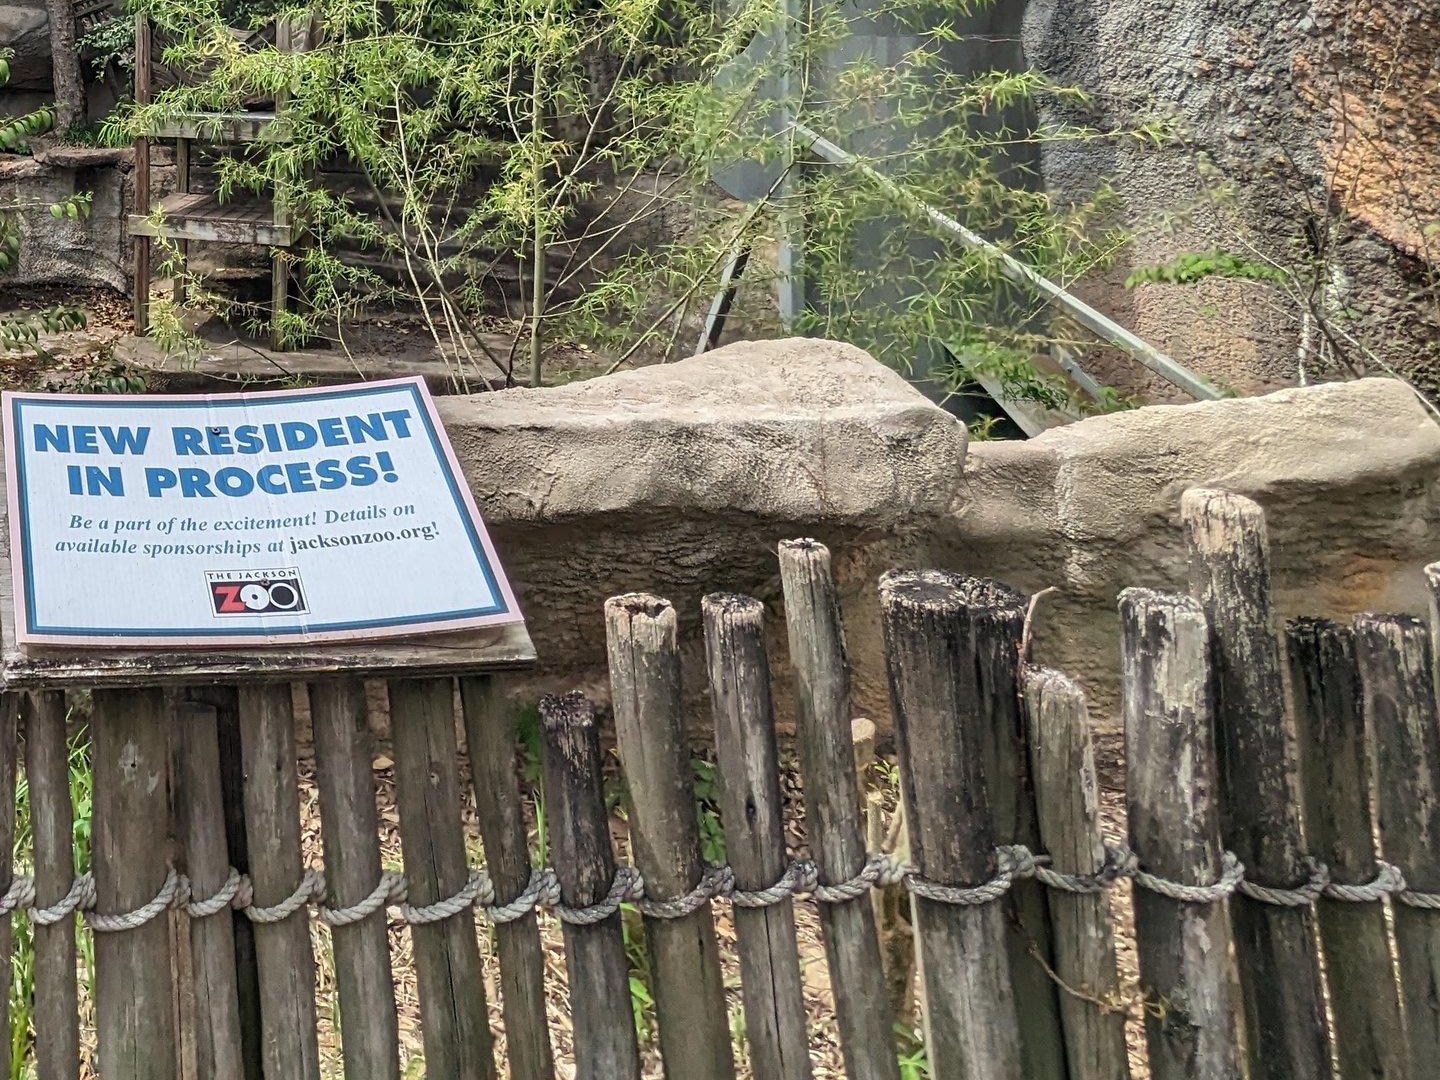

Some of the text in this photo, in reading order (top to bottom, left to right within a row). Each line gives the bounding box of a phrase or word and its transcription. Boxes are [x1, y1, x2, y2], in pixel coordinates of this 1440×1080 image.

[33, 409, 412, 456] NEW RESIDENT
[66, 451, 398, 498] IN PROCESS!
[69, 504, 415, 535] Be a part of the excitement! Details on
[55, 521, 440, 558] available sponsorships at jacksonzoo.org!
[207, 569, 297, 581] THE JACKSON
[215, 582, 298, 611] ZOO
